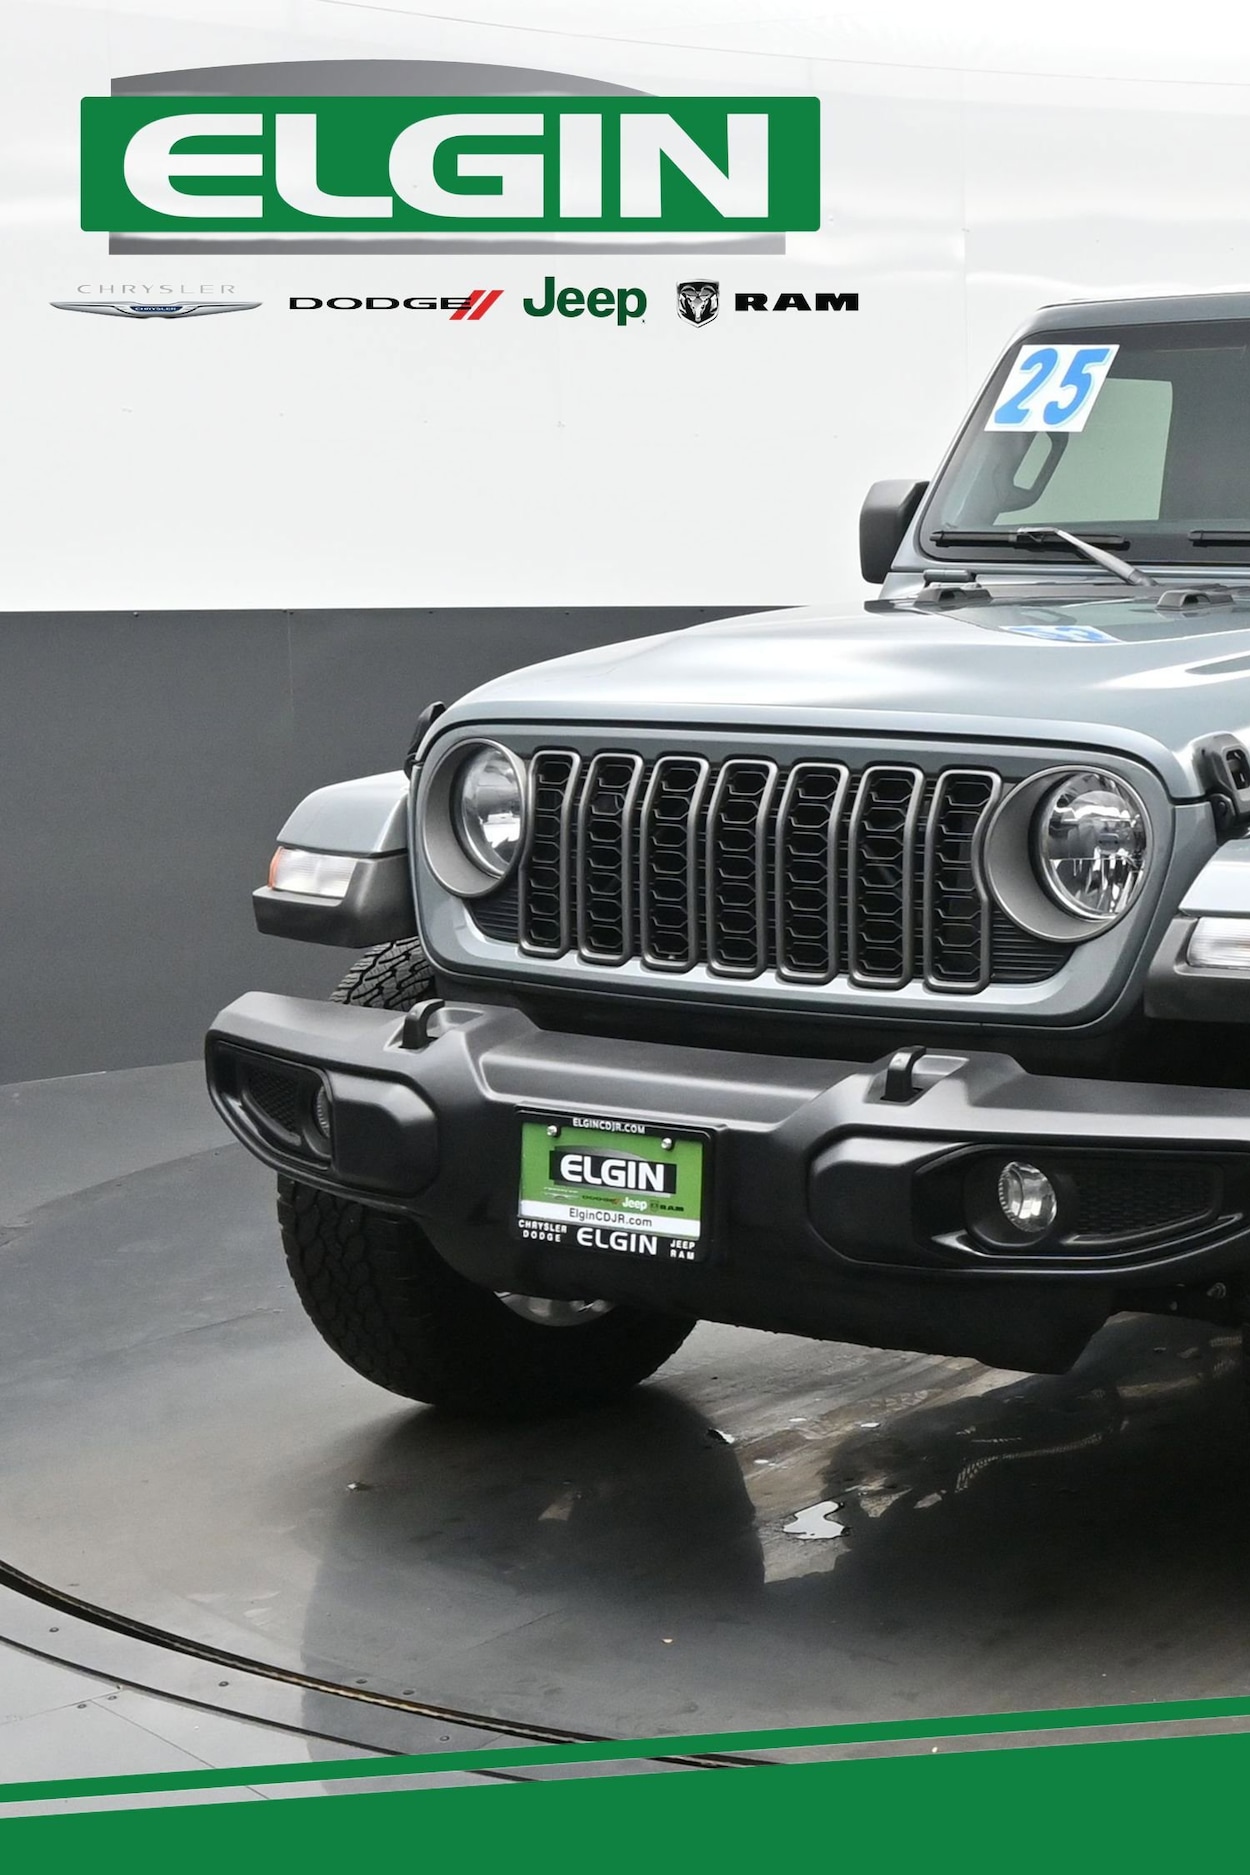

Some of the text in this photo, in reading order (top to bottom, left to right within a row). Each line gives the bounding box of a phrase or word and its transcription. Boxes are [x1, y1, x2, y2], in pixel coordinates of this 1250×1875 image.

[993, 347, 1112, 426] 25
[572, 1117, 646, 1135] ELGINCDJR.COM
[560, 1154, 665, 1192] ELGIN
[622, 1197, 648, 1212] Jeep
[569, 1207, 653, 1228] ElginCDJR.com
[518, 1219, 568, 1234] CHRYSLER
[522, 1229, 562, 1243] DODGE
[576, 1226, 658, 1256] ELGIN
[670, 1239, 696, 1250] JEEP
[670, 1250, 695, 1261] RAM
